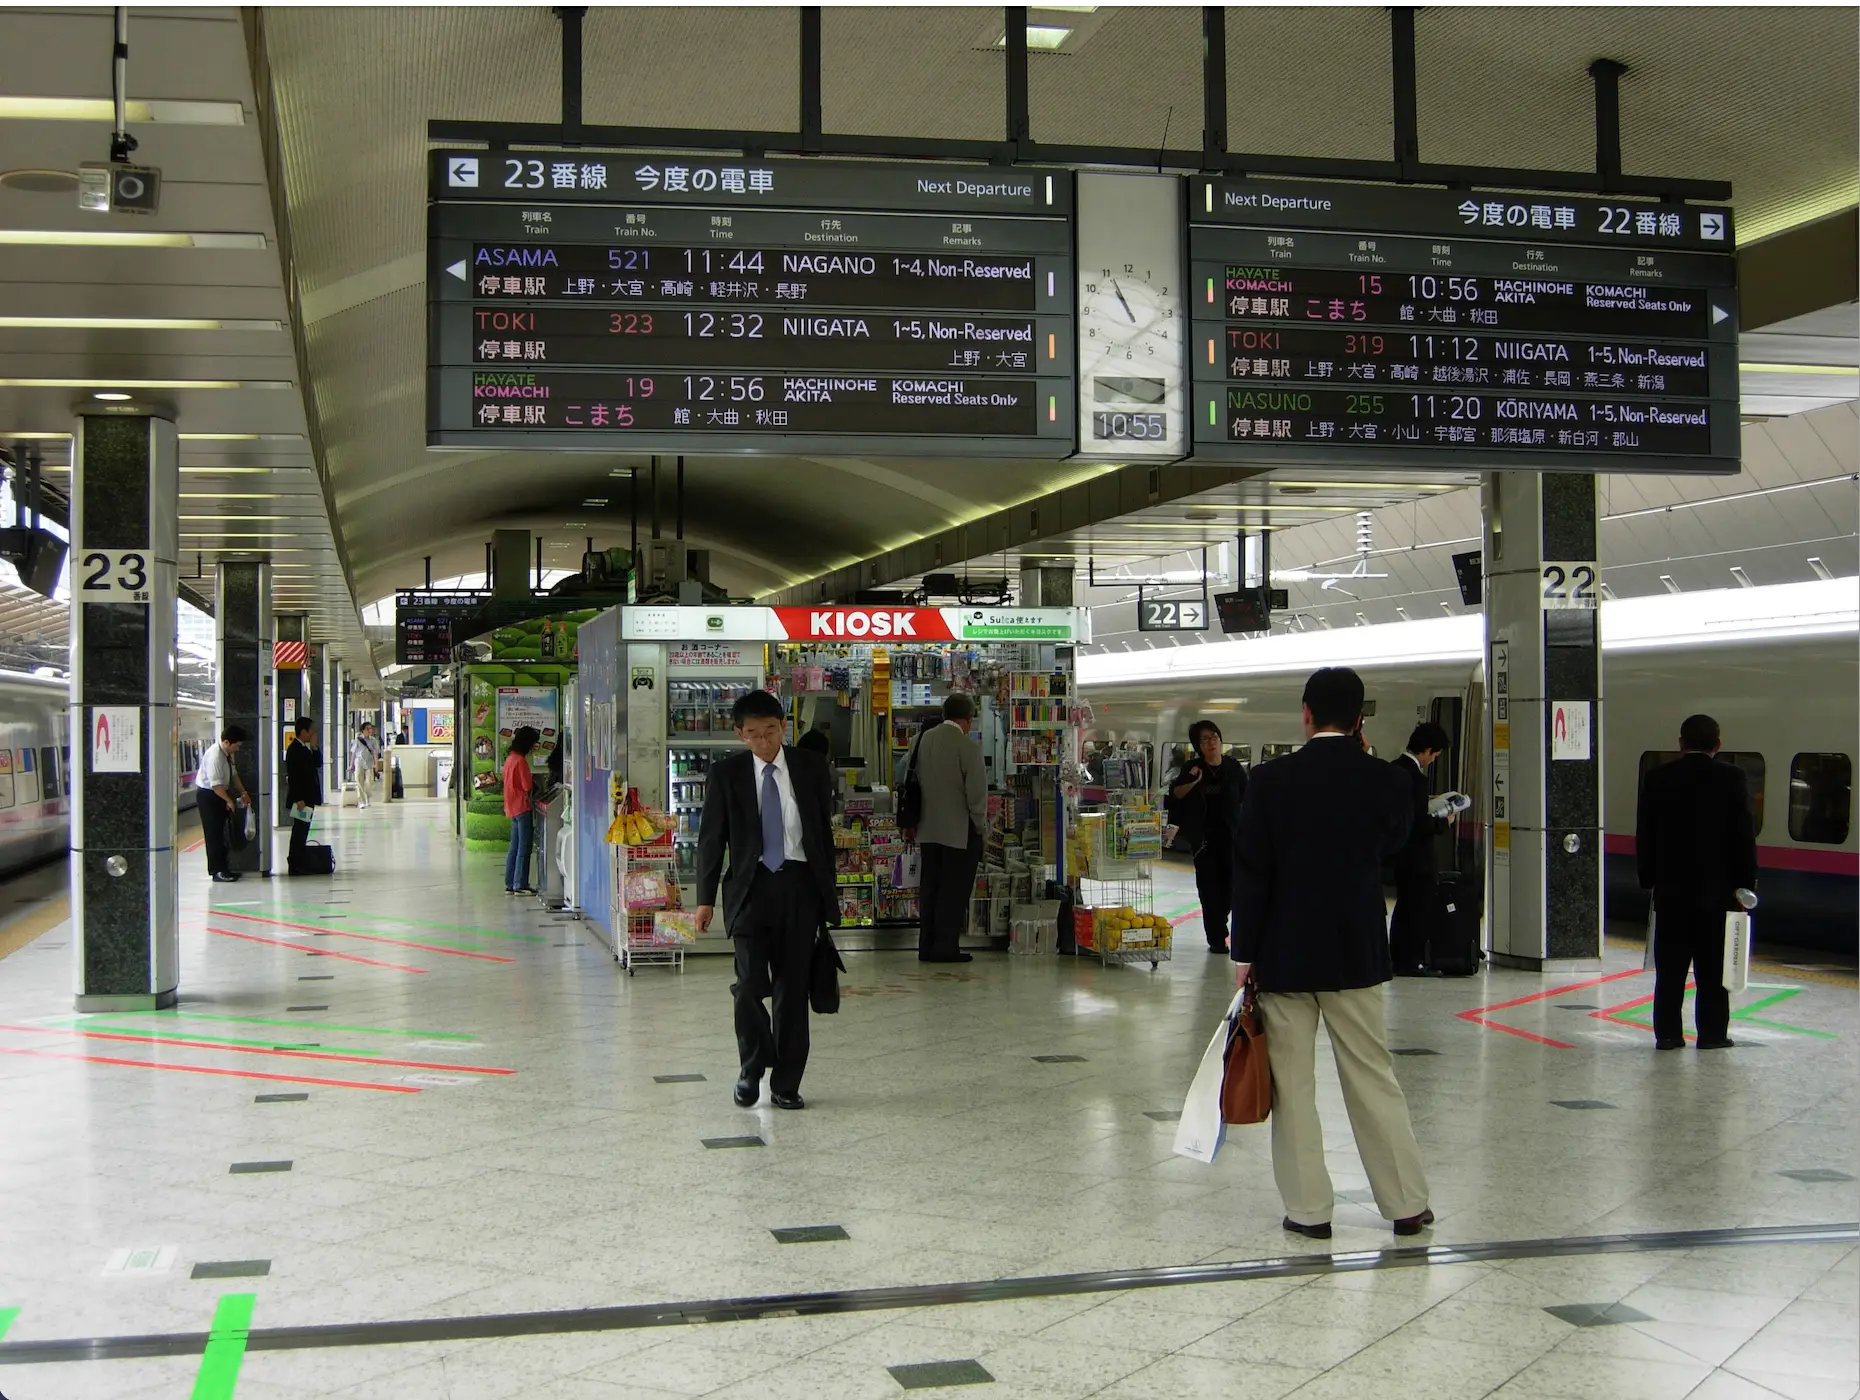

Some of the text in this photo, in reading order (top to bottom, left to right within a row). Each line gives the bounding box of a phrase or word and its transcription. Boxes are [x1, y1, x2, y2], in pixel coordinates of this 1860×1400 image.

[504, 159, 775, 194] 23番線 今度の電車
[917, 179, 1032, 197] Next Departure
[1225, 192, 1332, 211] Next Departure
[521, 211, 552, 223] 列車名
[625, 214, 647, 225] 番号
[711, 216, 732, 227] 時刻
[1457, 200, 1682, 237] 今度の電車 22番線
[525, 225, 549, 235] Train
[614, 227, 657, 237] Train No.
[821, 220, 841, 231] 行先
[951, 223, 972, 234] 記事
[710, 229, 734, 239] Time
[804, 232, 858, 243] Destination
[943, 236, 982, 246] Remarks
[1267, 236, 1295, 248] 列車名
[1358, 241, 1377, 252] 番号
[1270, 249, 1292, 259] Train
[1431, 244, 1451, 256] 時刻
[1526, 250, 1544, 261] 行先
[475, 248, 559, 267] ASAMA
[608, 250, 650, 270] 521
[684, 249, 765, 275] 11:44
[783, 255, 876, 275] NAGANO
[1349, 253, 1387, 264] Train No.
[1431, 257, 1452, 268] Time
[1637, 256, 1655, 266] 記事
[1102, 268, 1111, 278] 11
[1123, 264, 1133, 273] 12
[1225, 267, 1280, 280] HAYATE
[1512, 262, 1559, 273] Destination
[1629, 267, 1663, 279] Remarks
[1146, 270, 1151, 279] 1
[479, 275, 546, 296] 停車駅
[1086, 284, 1096, 293] 10
[1161, 287, 1168, 296] 2
[1226, 279, 1293, 293] KOMACHI
[1358, 275, 1479, 301] 15 10:56
[1494, 279, 1574, 295] HACHINOHE
[1585, 284, 1647, 299] KOMACHI
[1494, 291, 1536, 304] AKITA
[1083, 306, 1090, 316] 9
[1229, 296, 1290, 317] 停車駅
[1306, 299, 1367, 321] こまち
[1586, 297, 1692, 313] Reserved Seats Only
[1167, 309, 1173, 318] 3
[475, 312, 535, 330] TOKI
[609, 313, 653, 334] 323
[684, 312, 764, 338] 12:32
[783, 317, 870, 338] NIIGATA
[1089, 328, 1096, 338] 8
[1161, 330, 1168, 339] 4
[478, 339, 546, 360] 停車駅
[1105, 345, 1111, 355] 7
[1148, 346, 1154, 355] 5
[1227, 331, 1280, 350] TOKI
[1344, 334, 1384, 355] 319
[1409, 335, 1479, 361] 11:12
[1495, 341, 1569, 362] NIIGATA
[1126, 350, 1133, 360] 6
[1230, 357, 1291, 378] 停車駅
[474, 373, 536, 386] HAYATE
[783, 378, 877, 391] HACHINOHE
[474, 385, 550, 398] KOMACHI
[626, 376, 765, 401] 19 12:56
[892, 380, 964, 393] KOMACHI
[783, 390, 832, 403] AKITA
[892, 393, 1018, 407] Reserved Seats Only
[1228, 391, 1312, 411] NASUNO
[1346, 394, 1385, 415] 255
[1410, 394, 1481, 421] 11:20
[478, 404, 546, 424] 停車駅
[565, 403, 635, 426] こまち
[1099, 413, 1163, 438] 10:55
[1231, 417, 1293, 439] 停車駅
[82, 553, 147, 591] 23
[1543, 566, 1596, 598] 22
[1149, 603, 1177, 624] 22
[809, 611, 917, 636] KIOSK
